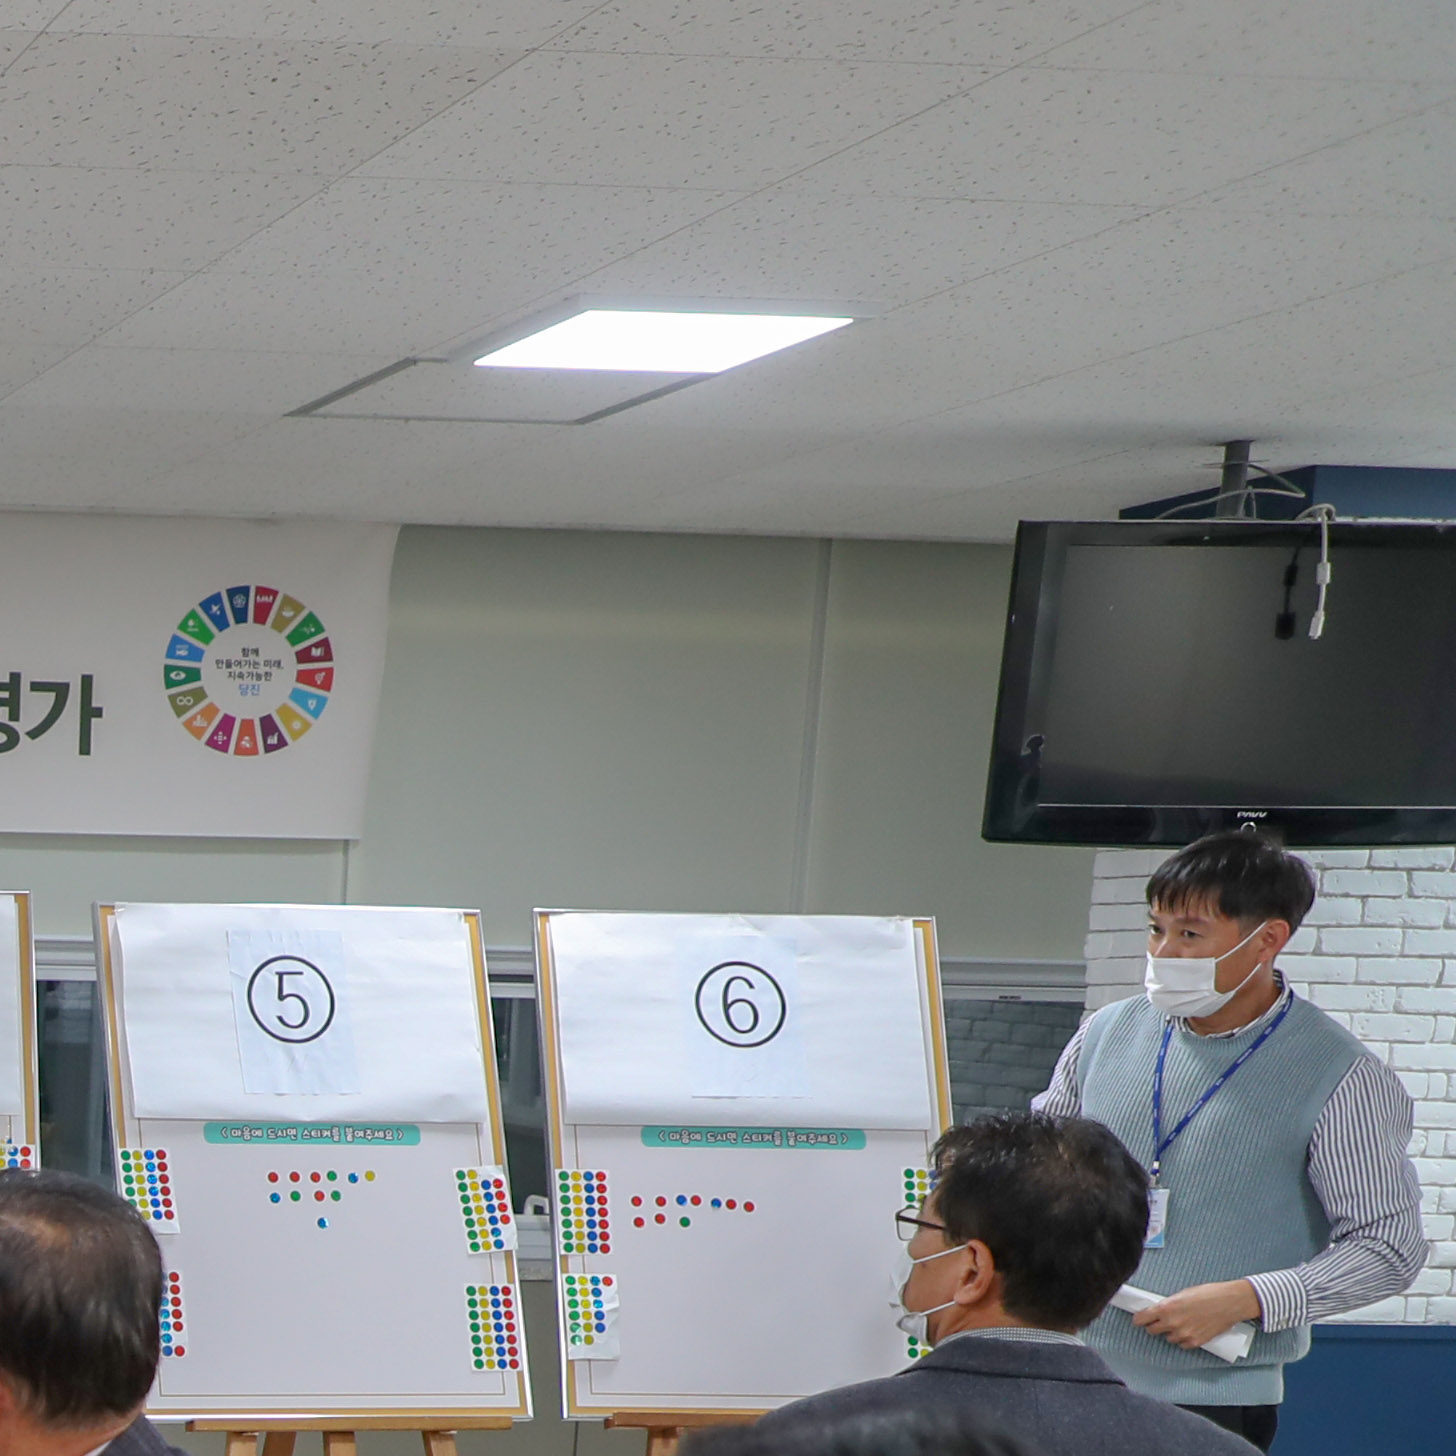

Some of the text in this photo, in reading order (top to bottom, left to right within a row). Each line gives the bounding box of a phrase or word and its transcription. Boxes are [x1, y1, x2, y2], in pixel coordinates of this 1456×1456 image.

[241, 648, 259, 657] 함께
[215, 659, 260, 669] 만들어가는
[227, 672, 272, 681] 지속가능한
[239, 685, 260, 696] 당진
[231, 1125, 393, 1142] 마음에 드시면 스티커를 붙여주세요
[670, 1130, 837, 1145] 마음에 드시면 스티커를 붙여주세요
